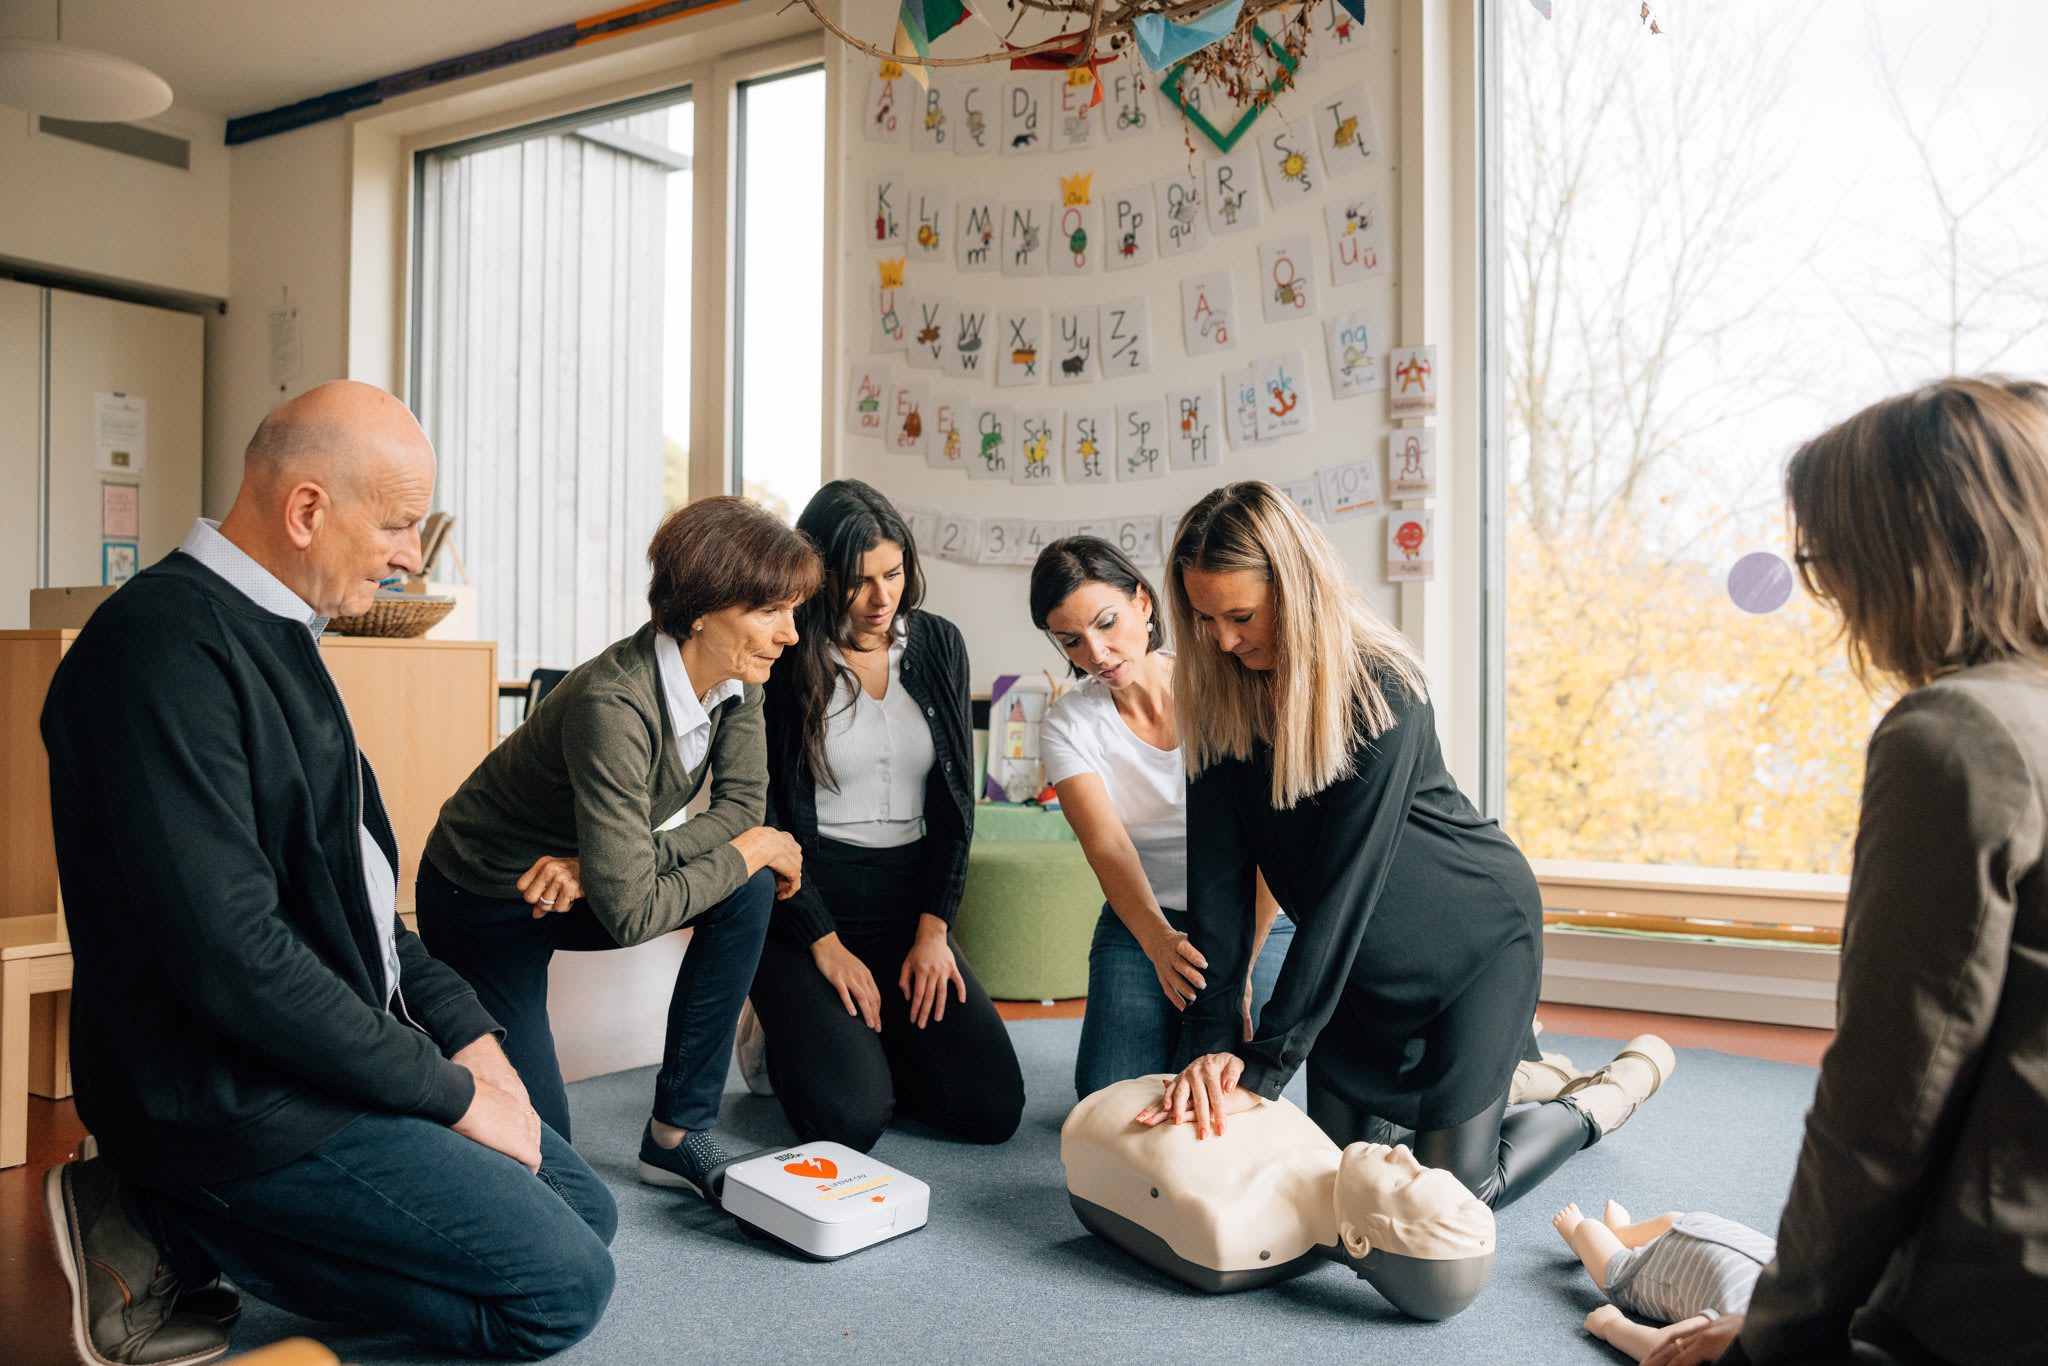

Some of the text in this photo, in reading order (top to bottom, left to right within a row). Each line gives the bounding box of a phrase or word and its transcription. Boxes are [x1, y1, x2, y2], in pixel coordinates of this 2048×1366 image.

[877, 78, 895, 107] A
[1356, 132, 1370, 156] t
[878, 182, 891, 208] K
[1299, 174, 1312, 192] s
[966, 205, 990, 235] M
[1012, 208, 1031, 237] N
[967, 248, 987, 265] m
[1016, 248, 1028, 265] n
[1073, 251, 1087, 269] o
[879, 288, 895, 316] U
[1110, 310, 1126, 340] Z
[931, 344, 942, 360] v
[1340, 323, 1368, 355] ng
[961, 354, 979, 370] w
[857, 373, 881, 398] Au
[1266, 365, 1294, 396] nk
[861, 412, 880, 429] au
[978, 411, 1003, 437] Ch
[1022, 418, 1052, 443] Sch
[1076, 417, 1097, 443] St
[1127, 411, 1151, 445] Sp
[1191, 423, 1210, 462] pf
[985, 451, 1006, 472] ch
[1024, 462, 1051, 479] sch
[1083, 450, 1102, 477] st
[1139, 447, 1160, 473] sp
[1328, 467, 1359, 496] 10
[943, 523, 960, 552] 2
[989, 525, 1005, 554] 3
[1027, 525, 1046, 554] 4
[1119, 521, 1137, 552] 6
